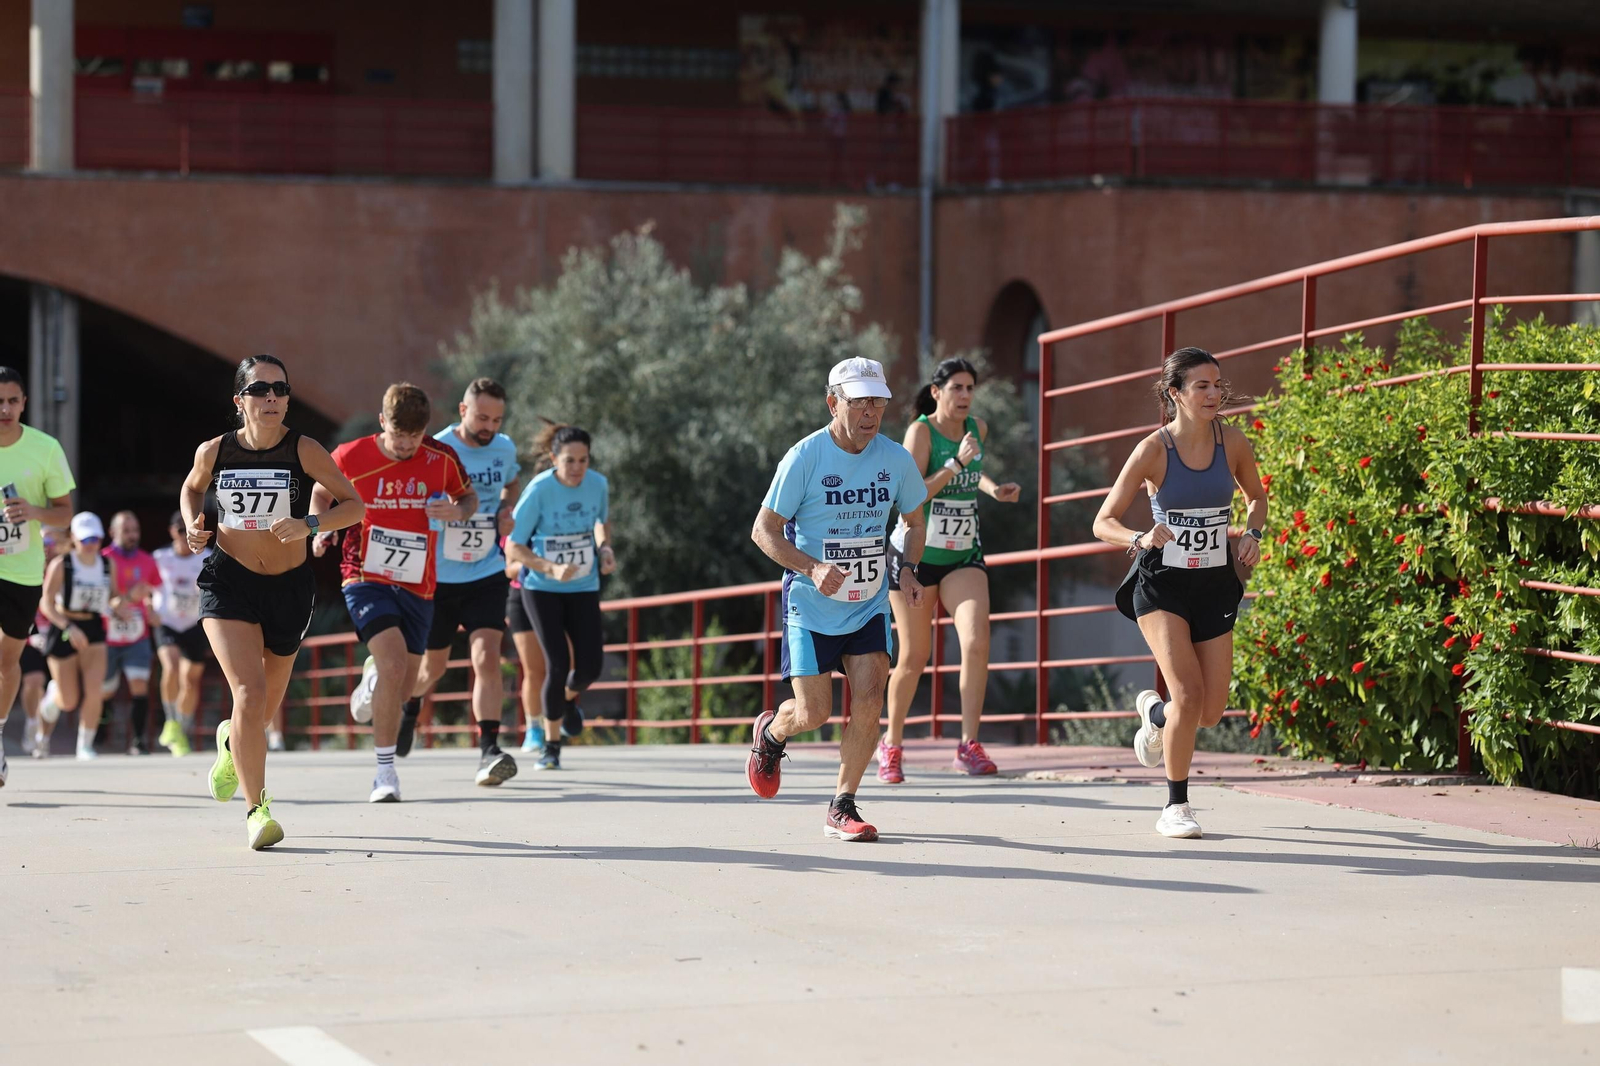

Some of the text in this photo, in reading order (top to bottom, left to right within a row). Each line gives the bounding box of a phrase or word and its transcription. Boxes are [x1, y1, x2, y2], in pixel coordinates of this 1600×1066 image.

[222, 480, 252, 488] UMA
[469, 468, 502, 486] erja
[822, 477, 842, 486] TROPS
[230, 491, 279, 514] 377
[825, 481, 891, 508] nerja
[836, 510, 883, 520] ATLETISMO
[934, 507, 958, 516] UMA
[939, 518, 972, 536] 172
[1170, 516, 1201, 526] UMA
[372, 533, 397, 546] UMA
[461, 530, 483, 548] 25
[1177, 528, 1220, 551] 491
[384, 547, 411, 568] 77
[555, 550, 586, 566] 471
[826, 549, 858, 558] UMA
